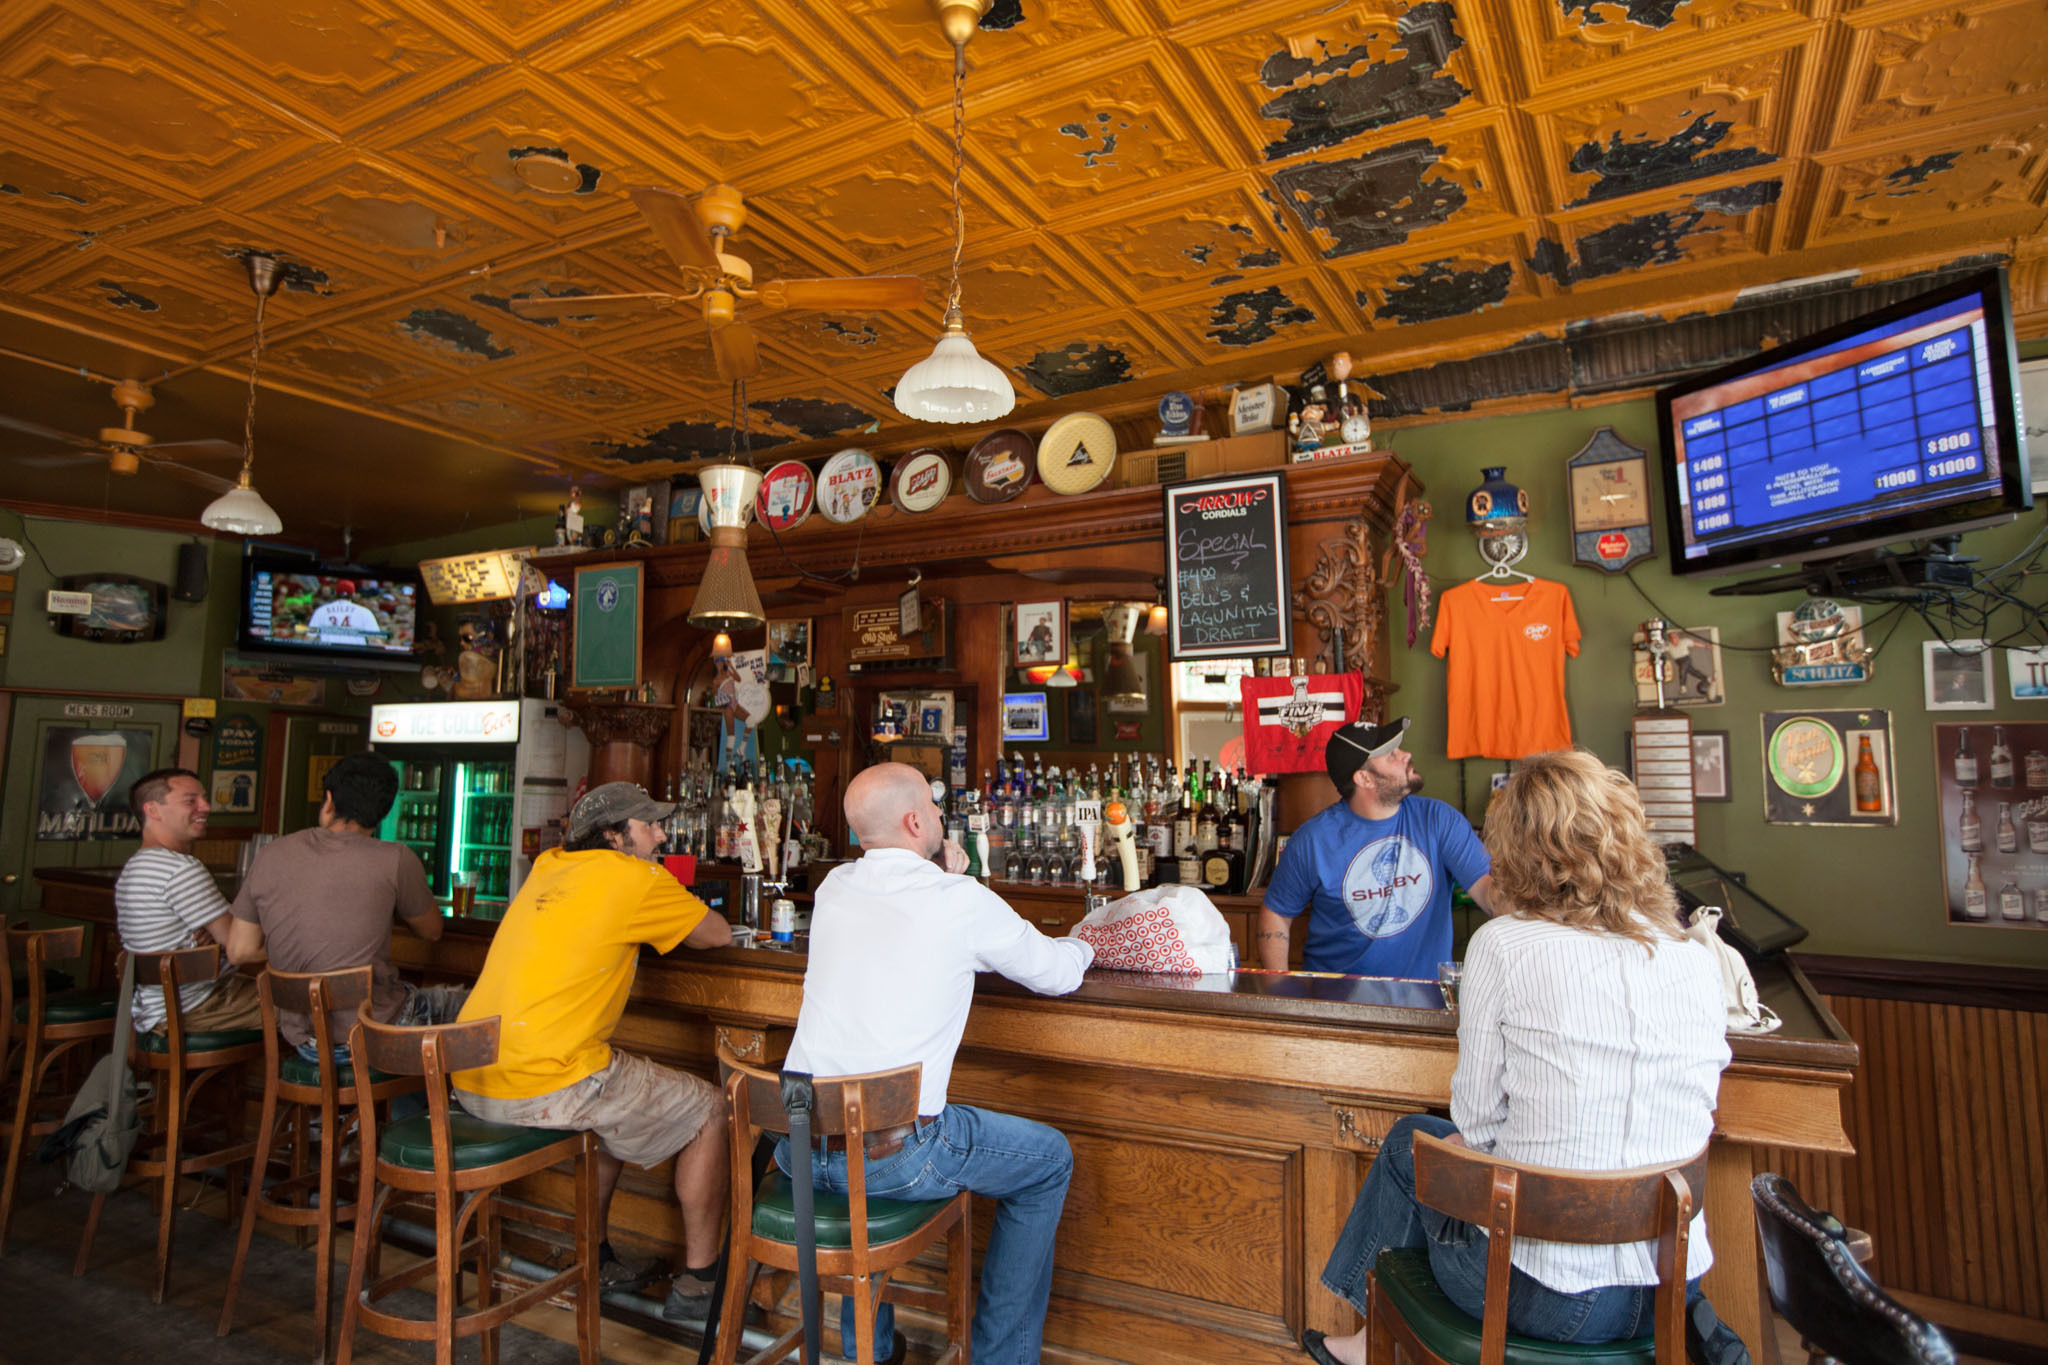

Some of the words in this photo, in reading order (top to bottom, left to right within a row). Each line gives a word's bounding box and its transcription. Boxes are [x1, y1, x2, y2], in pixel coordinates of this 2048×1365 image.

[1238, 400, 1266, 414] Meister
[1928, 432, 1971, 454] $800
[1313, 447, 1351, 460] BLATZ
[1693, 455, 1723, 473] $400
[1928, 455, 1976, 477] $1000
[828, 467, 873, 486] BLATZ
[1807, 486, 1839, 499] FLAVOR
[1180, 488, 1267, 514] ARROW
[1202, 507, 1247, 520] CORDIALS
[1180, 587, 1232, 609] BELL'S
[1180, 602, 1278, 627] LAGUNITAS
[114, 630, 144, 639] TAP
[861, 632, 877, 645] Old
[877, 631, 897, 645] Style
[1195, 623, 1261, 644] DRAFT
[1791, 665, 1857, 681] SCHLITZ
[68, 704, 98, 716] MENS
[102, 705, 131, 717] ROOM
[1281, 704, 1325, 717] FINAL
[410, 713, 436, 736] ICE
[443, 711, 483, 735] COLD
[926, 714, 935, 730] 3
[221, 728, 256, 738] PAY
[218, 738, 256, 746] TODAY
[38, 810, 142, 834] MATILDA
[1078, 807, 1098, 821] IPA
